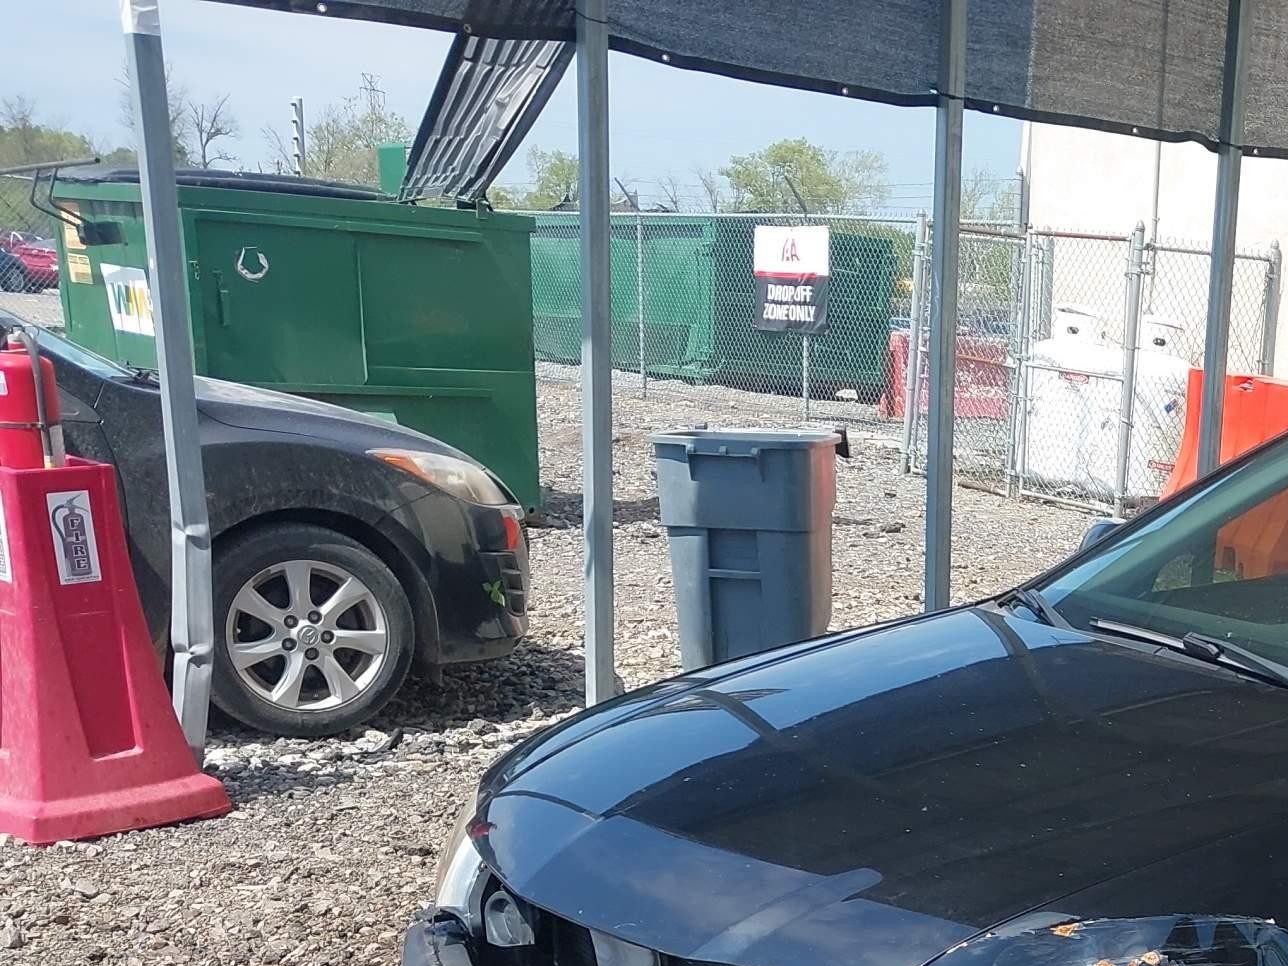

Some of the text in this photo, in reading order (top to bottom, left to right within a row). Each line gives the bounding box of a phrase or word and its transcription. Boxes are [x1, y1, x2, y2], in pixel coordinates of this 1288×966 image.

[763, 303, 816, 322] ZONE ONLY
[69, 518, 88, 569] FIRE
